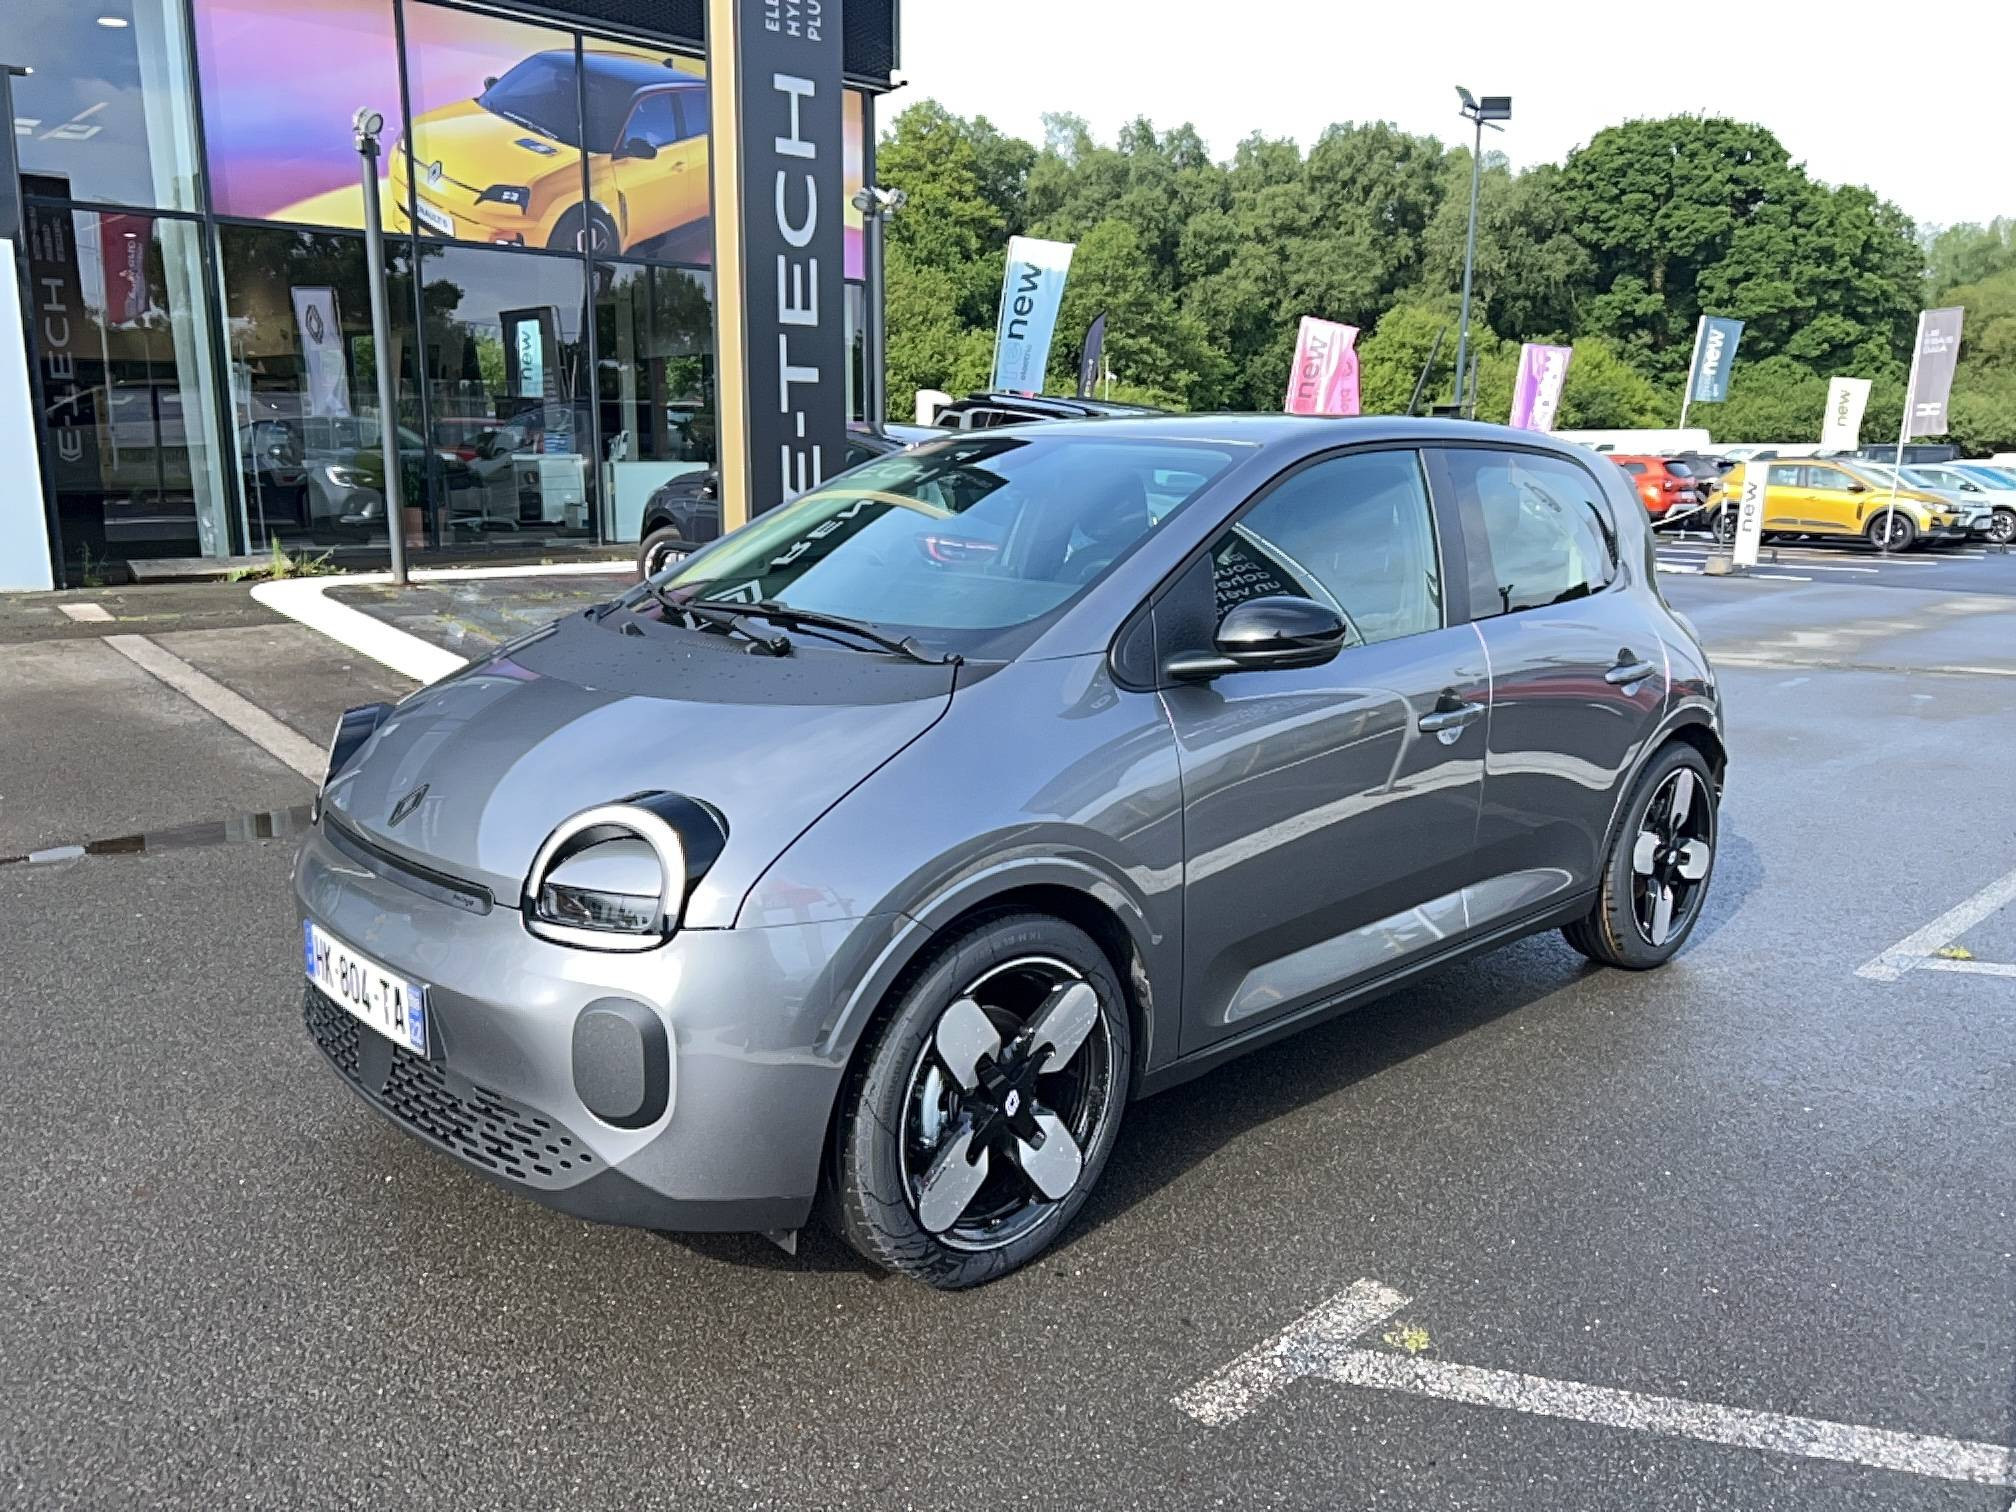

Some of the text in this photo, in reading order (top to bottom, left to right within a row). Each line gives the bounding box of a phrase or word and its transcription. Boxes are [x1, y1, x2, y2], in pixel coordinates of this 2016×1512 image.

[787, 0, 801, 37] HY
[773, 72, 821, 505] E-TECH
[520, 331, 533, 380] new
[1298, 335, 1328, 399] new
[1837, 389, 1851, 428] new
[1741, 481, 1758, 533] new
